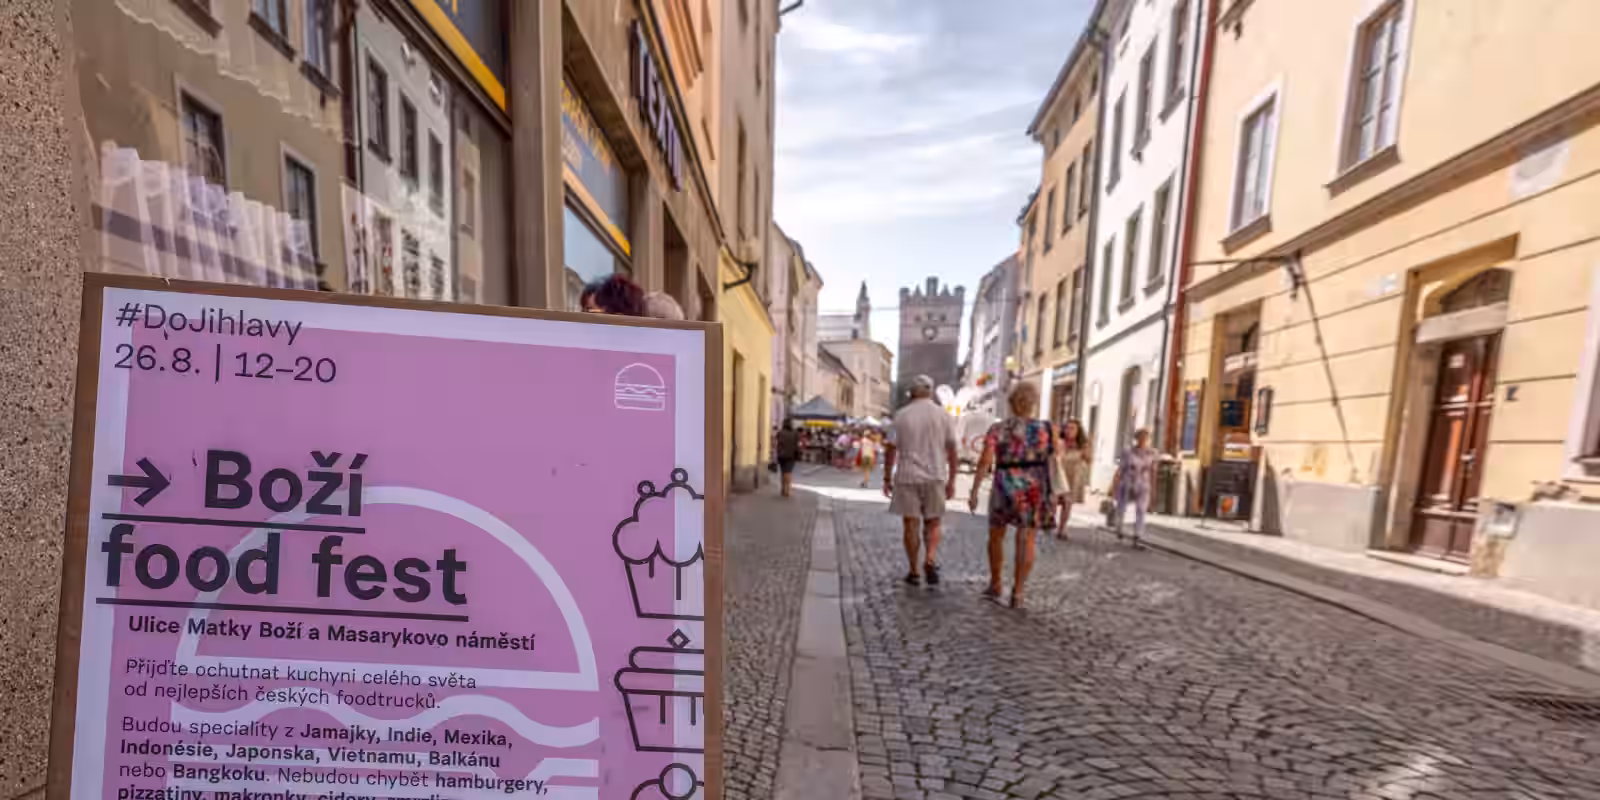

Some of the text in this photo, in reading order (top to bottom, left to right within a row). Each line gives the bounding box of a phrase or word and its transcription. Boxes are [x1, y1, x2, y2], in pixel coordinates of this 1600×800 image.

[116, 302, 302, 345] #DoJihlavy
[114, 344, 201, 374] 26.8.
[204, 449, 369, 516] Boží
[101, 523, 467, 605] food fest
[128, 615, 535, 650] Ulice Matky Boží a Masarykovo náměstí
[126, 658, 476, 689] Přijďte ochutnat kuchyni celého světa
[124, 681, 441, 709] od nejlepších českých foodtrucků.
[122, 716, 513, 749] Budou speciality z Jamajky, Indie, Mexika,
[120, 739, 500, 768] Indonésie, Japonska, Vietnamu, Balkánu
[119, 763, 548, 795] nebo Bangkoku. Nebudou chybět hamburgery,
